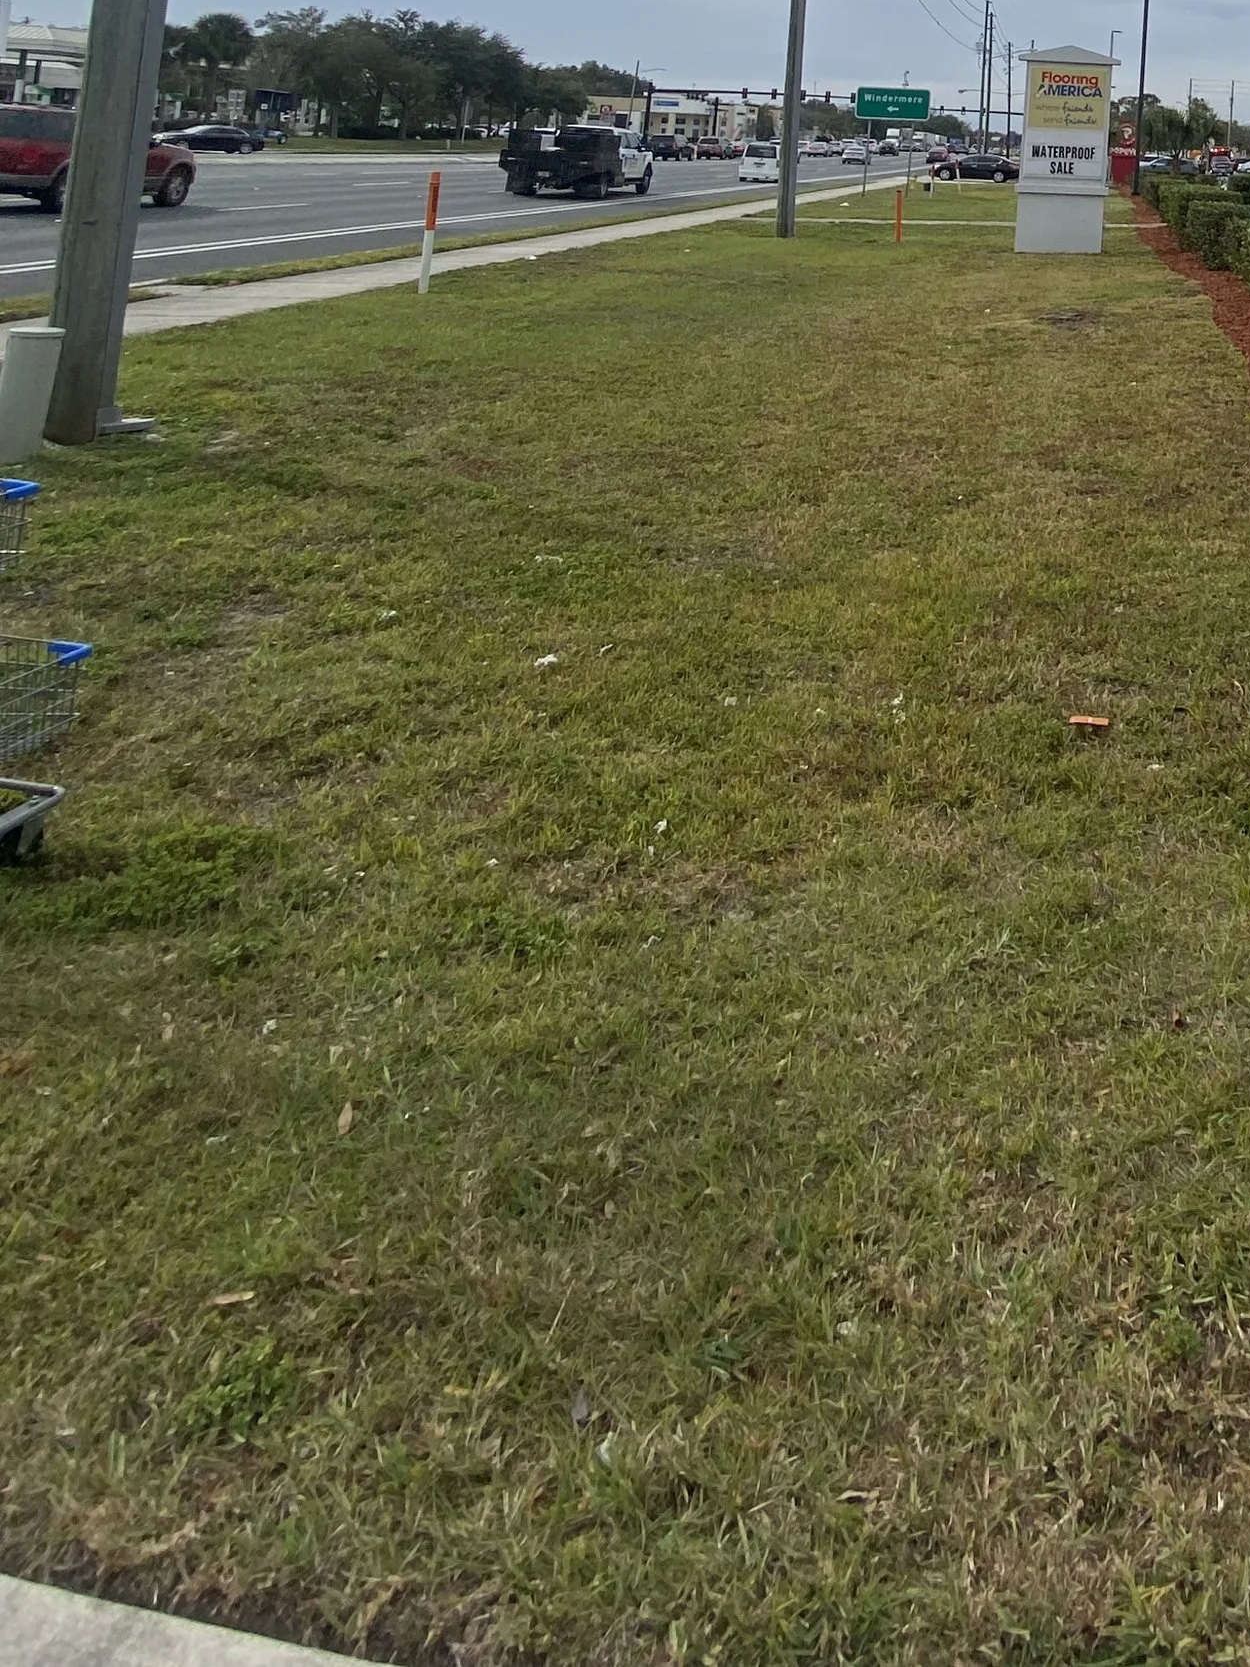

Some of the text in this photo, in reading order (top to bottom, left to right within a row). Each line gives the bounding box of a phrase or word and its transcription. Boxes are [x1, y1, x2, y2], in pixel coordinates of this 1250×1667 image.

[1041, 71, 1099, 88] Flooring
[1037, 84, 1103, 98] AMERICA
[1062, 101, 1094, 114] friends
[1031, 145, 1096, 160] WATERPROOF
[1050, 161, 1075, 175] SALE
